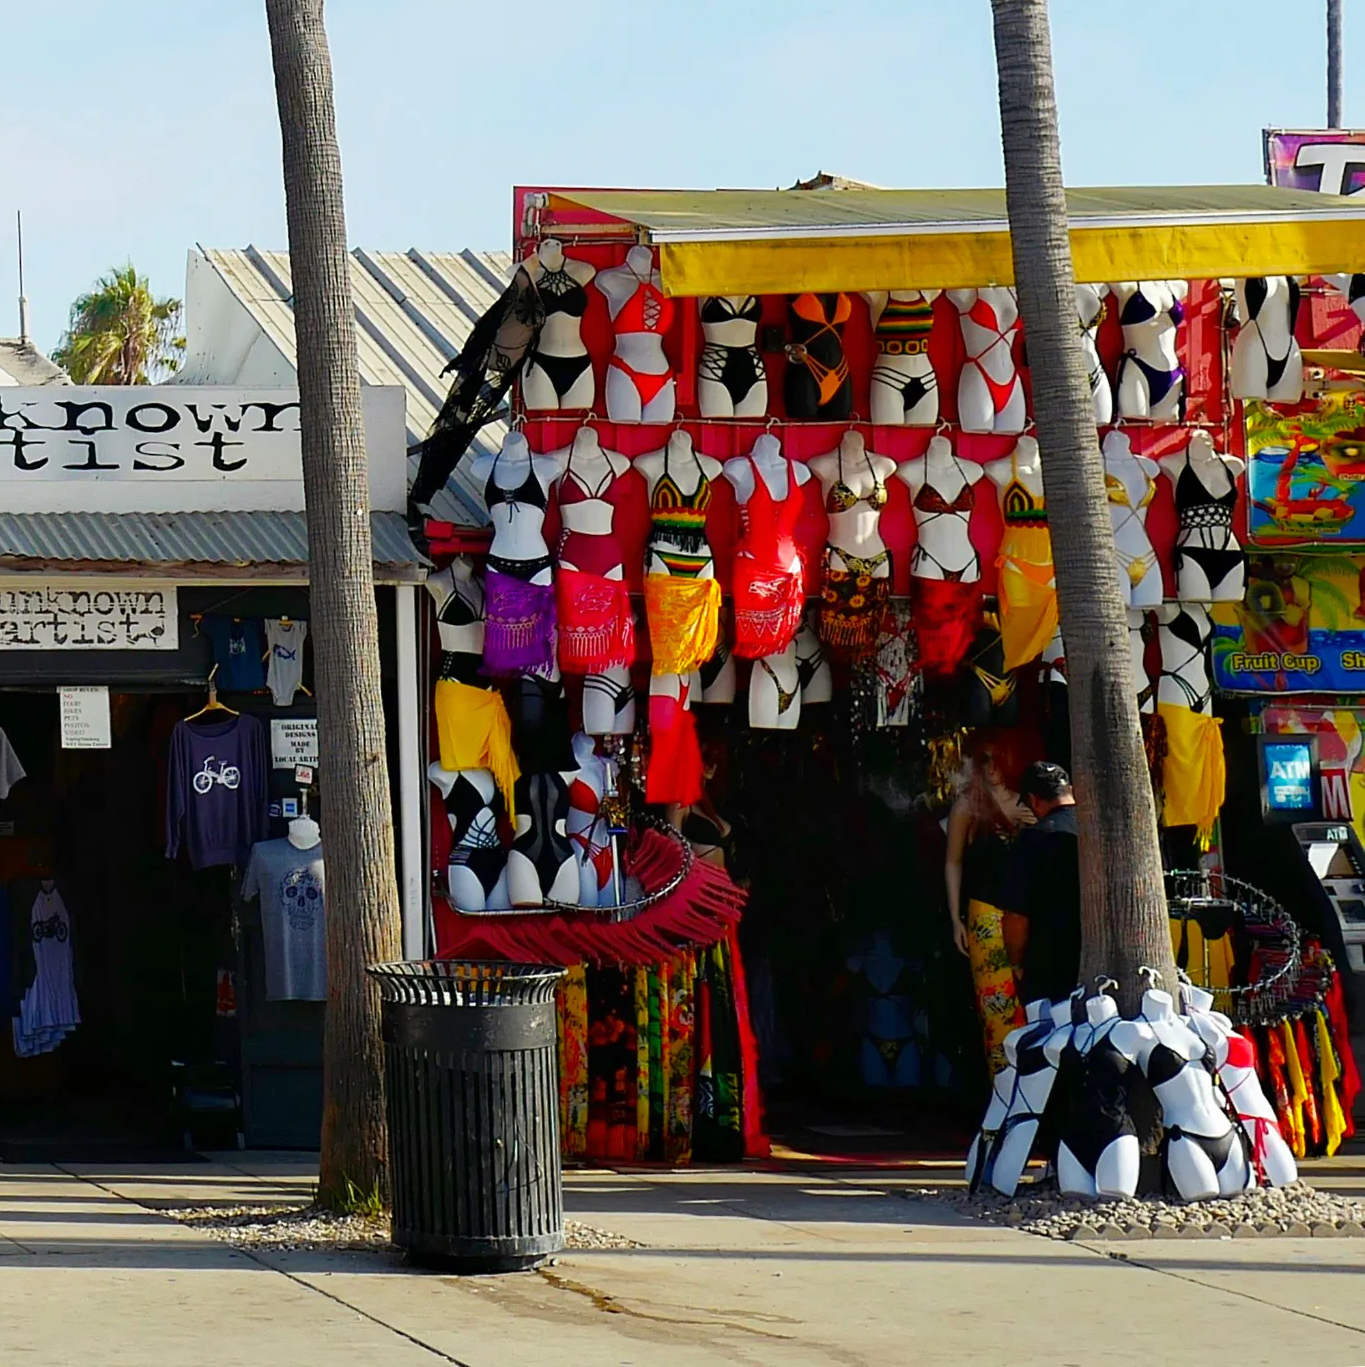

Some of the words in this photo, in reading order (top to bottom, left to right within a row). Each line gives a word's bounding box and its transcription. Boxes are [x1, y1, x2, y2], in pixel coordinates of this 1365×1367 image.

[1231, 652, 1279, 672] Fruit
[1281, 652, 1320, 674] Cup
[1270, 761, 1310, 780] ATM
[1326, 826, 1348, 841] ATM
